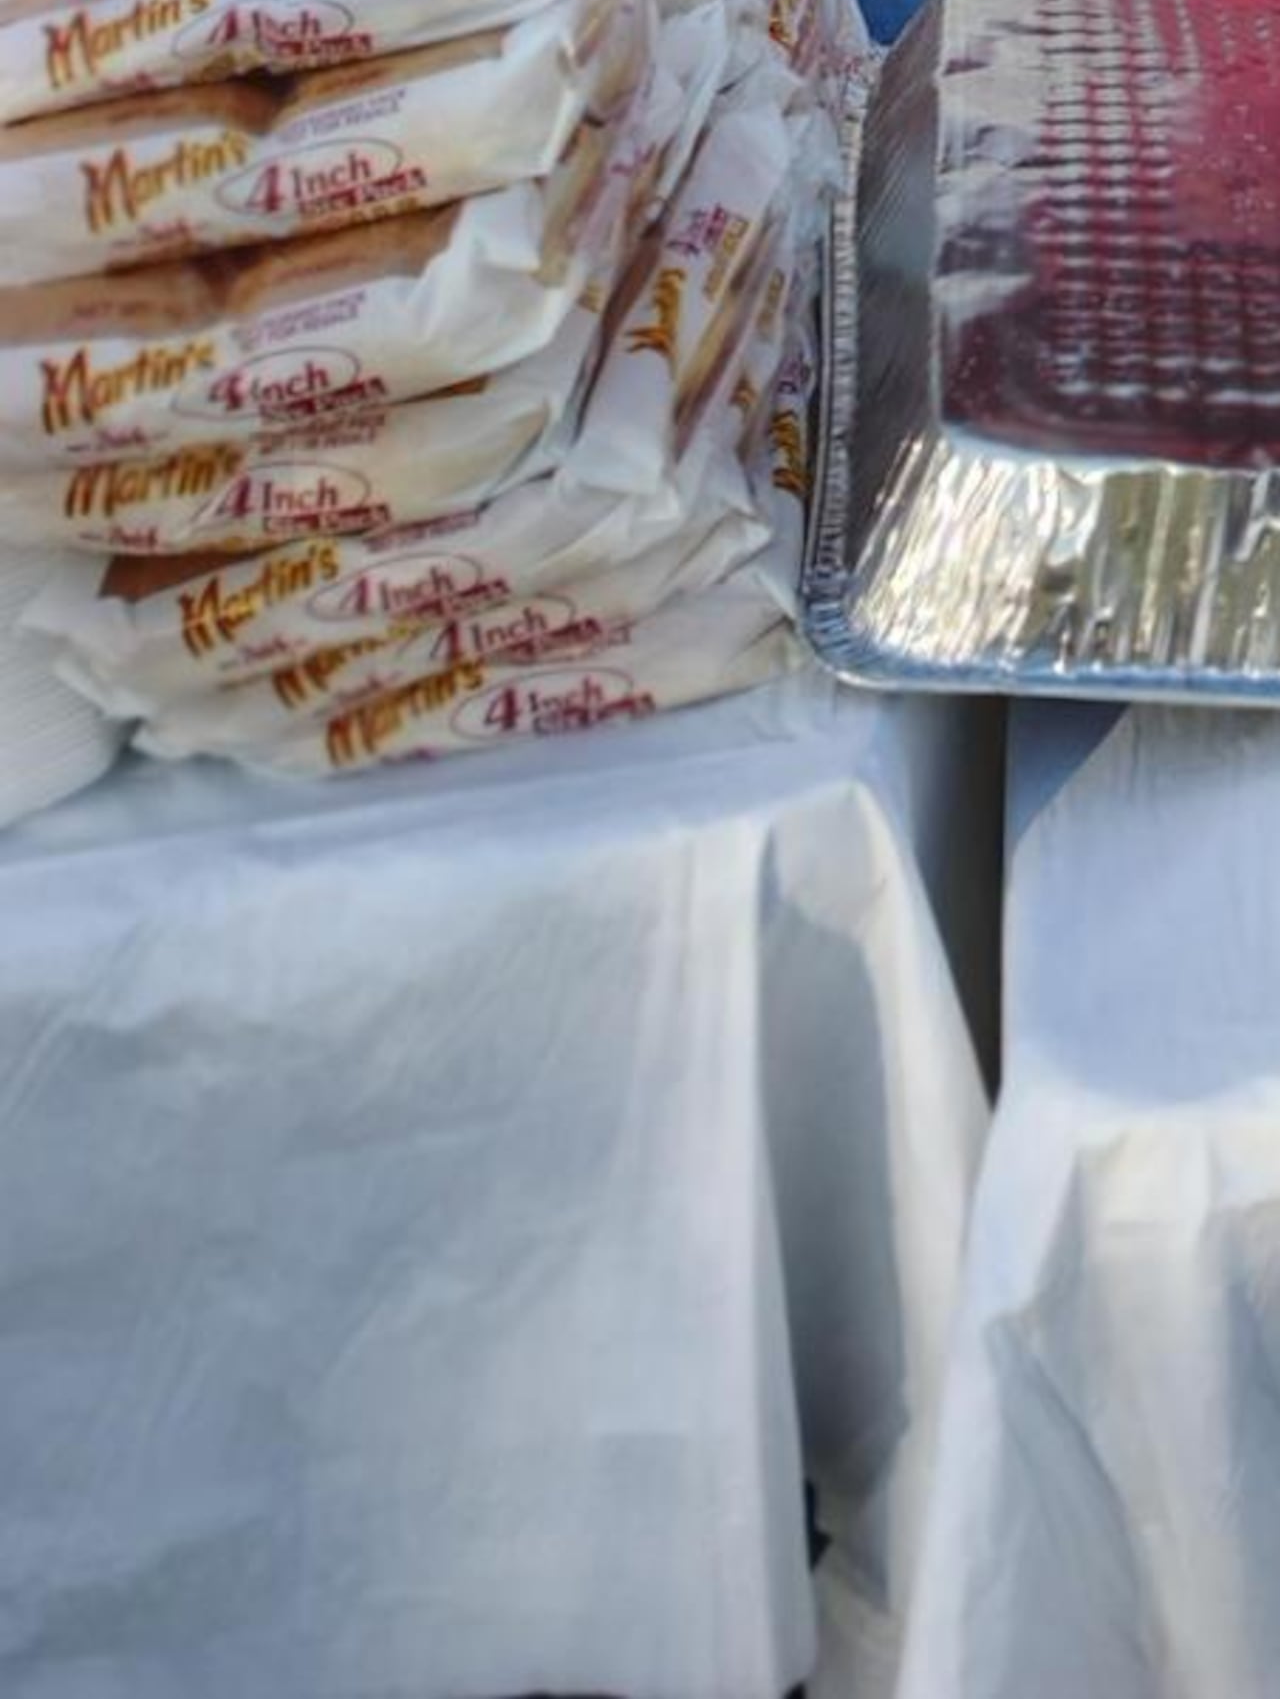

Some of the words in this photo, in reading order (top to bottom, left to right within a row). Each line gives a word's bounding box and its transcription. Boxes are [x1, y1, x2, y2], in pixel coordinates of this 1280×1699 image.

[78, 129, 251, 234] Martin's
[244, 163, 284, 213] 4
[289, 151, 372, 200] Inch
[39, 342, 215, 435] Martin's
[250, 360, 330, 403] Inch
[262, 476, 339, 512] Inch
[178, 539, 340, 658] Martin's
[379, 565, 453, 612] Inch
[471, 606, 547, 652] Inch
[484, 687, 520, 731] 4
